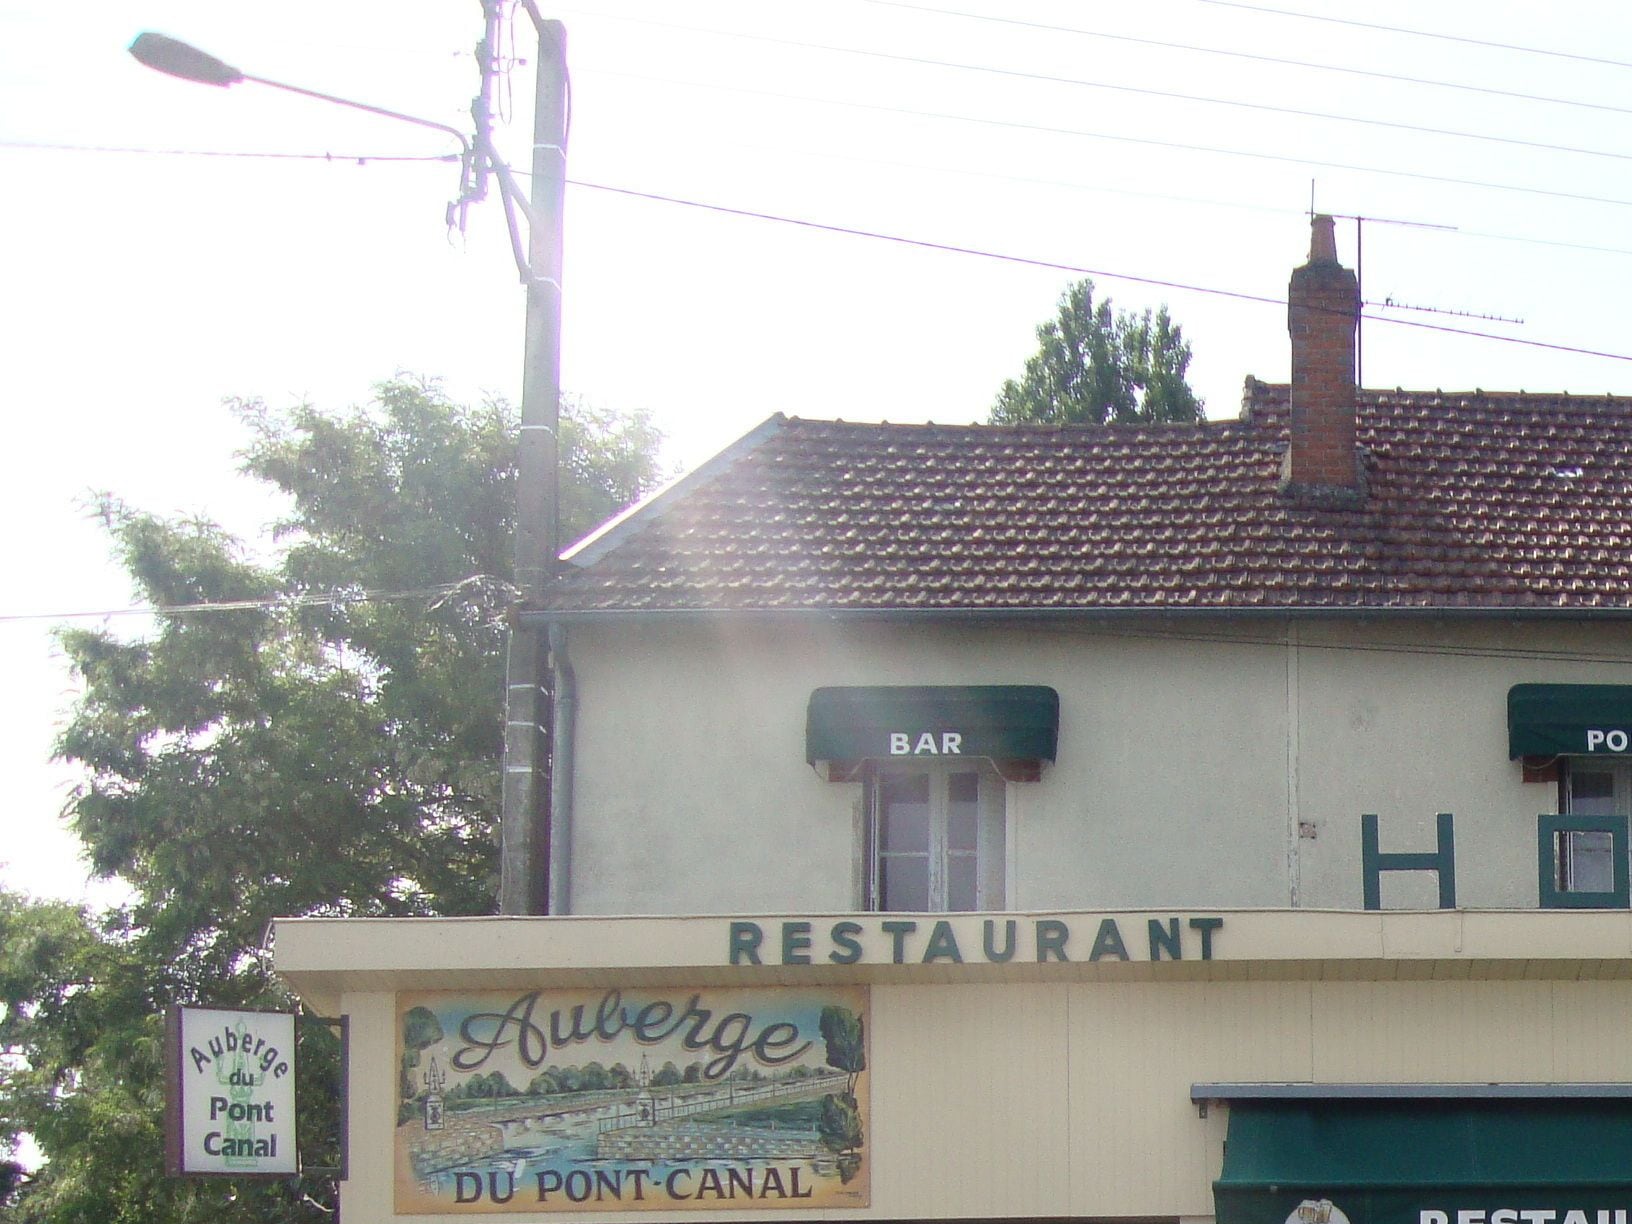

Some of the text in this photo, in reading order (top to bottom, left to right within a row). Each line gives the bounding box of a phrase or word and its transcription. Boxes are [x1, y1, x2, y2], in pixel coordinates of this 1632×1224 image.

[889, 731, 962, 755] BAR
[728, 917, 1224, 965] RESTAURANT
[449, 989, 814, 1081] Auberge
[190, 1026, 289, 1079] Auberge
[229, 1068, 254, 1086] du
[210, 1096, 275, 1122] Pont
[203, 1131, 278, 1157] Canal
[454, 1170, 516, 1204] DU
